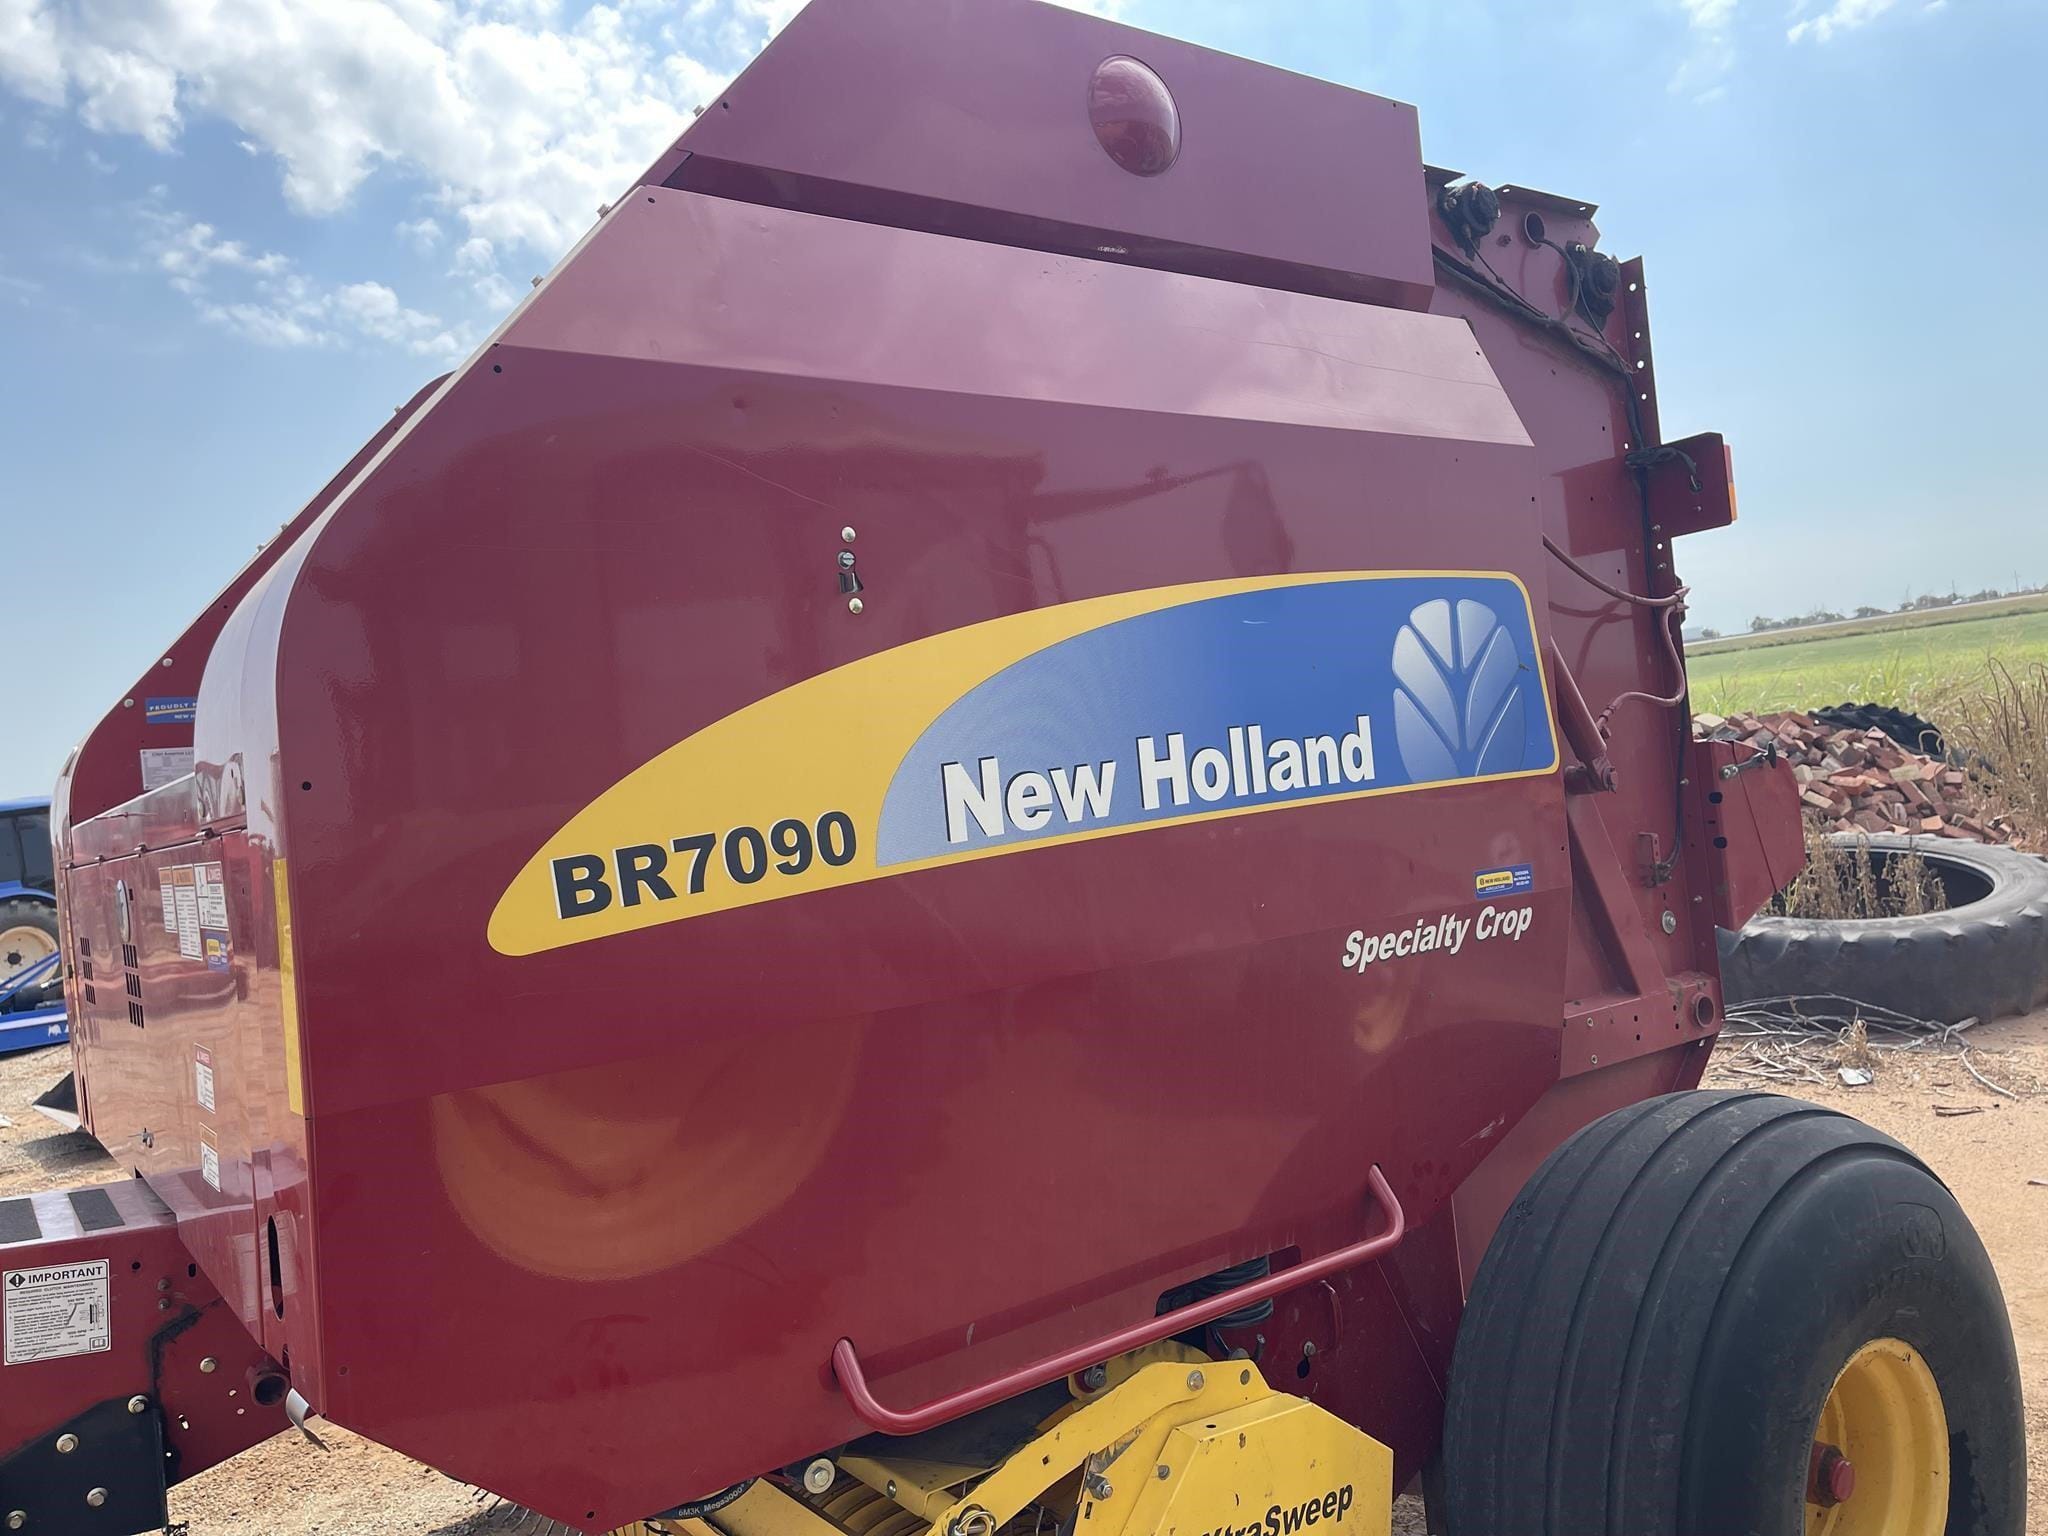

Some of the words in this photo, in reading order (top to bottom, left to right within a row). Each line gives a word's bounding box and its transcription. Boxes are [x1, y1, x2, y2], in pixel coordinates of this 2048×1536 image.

[941, 756, 1117, 844] New
[1136, 715, 1376, 810] Holland
[549, 811, 857, 920] BR7090
[1342, 913, 1471, 974] Specialty
[1475, 905, 1533, 941] Crop
[28, 1266, 103, 1284] IMPORTANT
